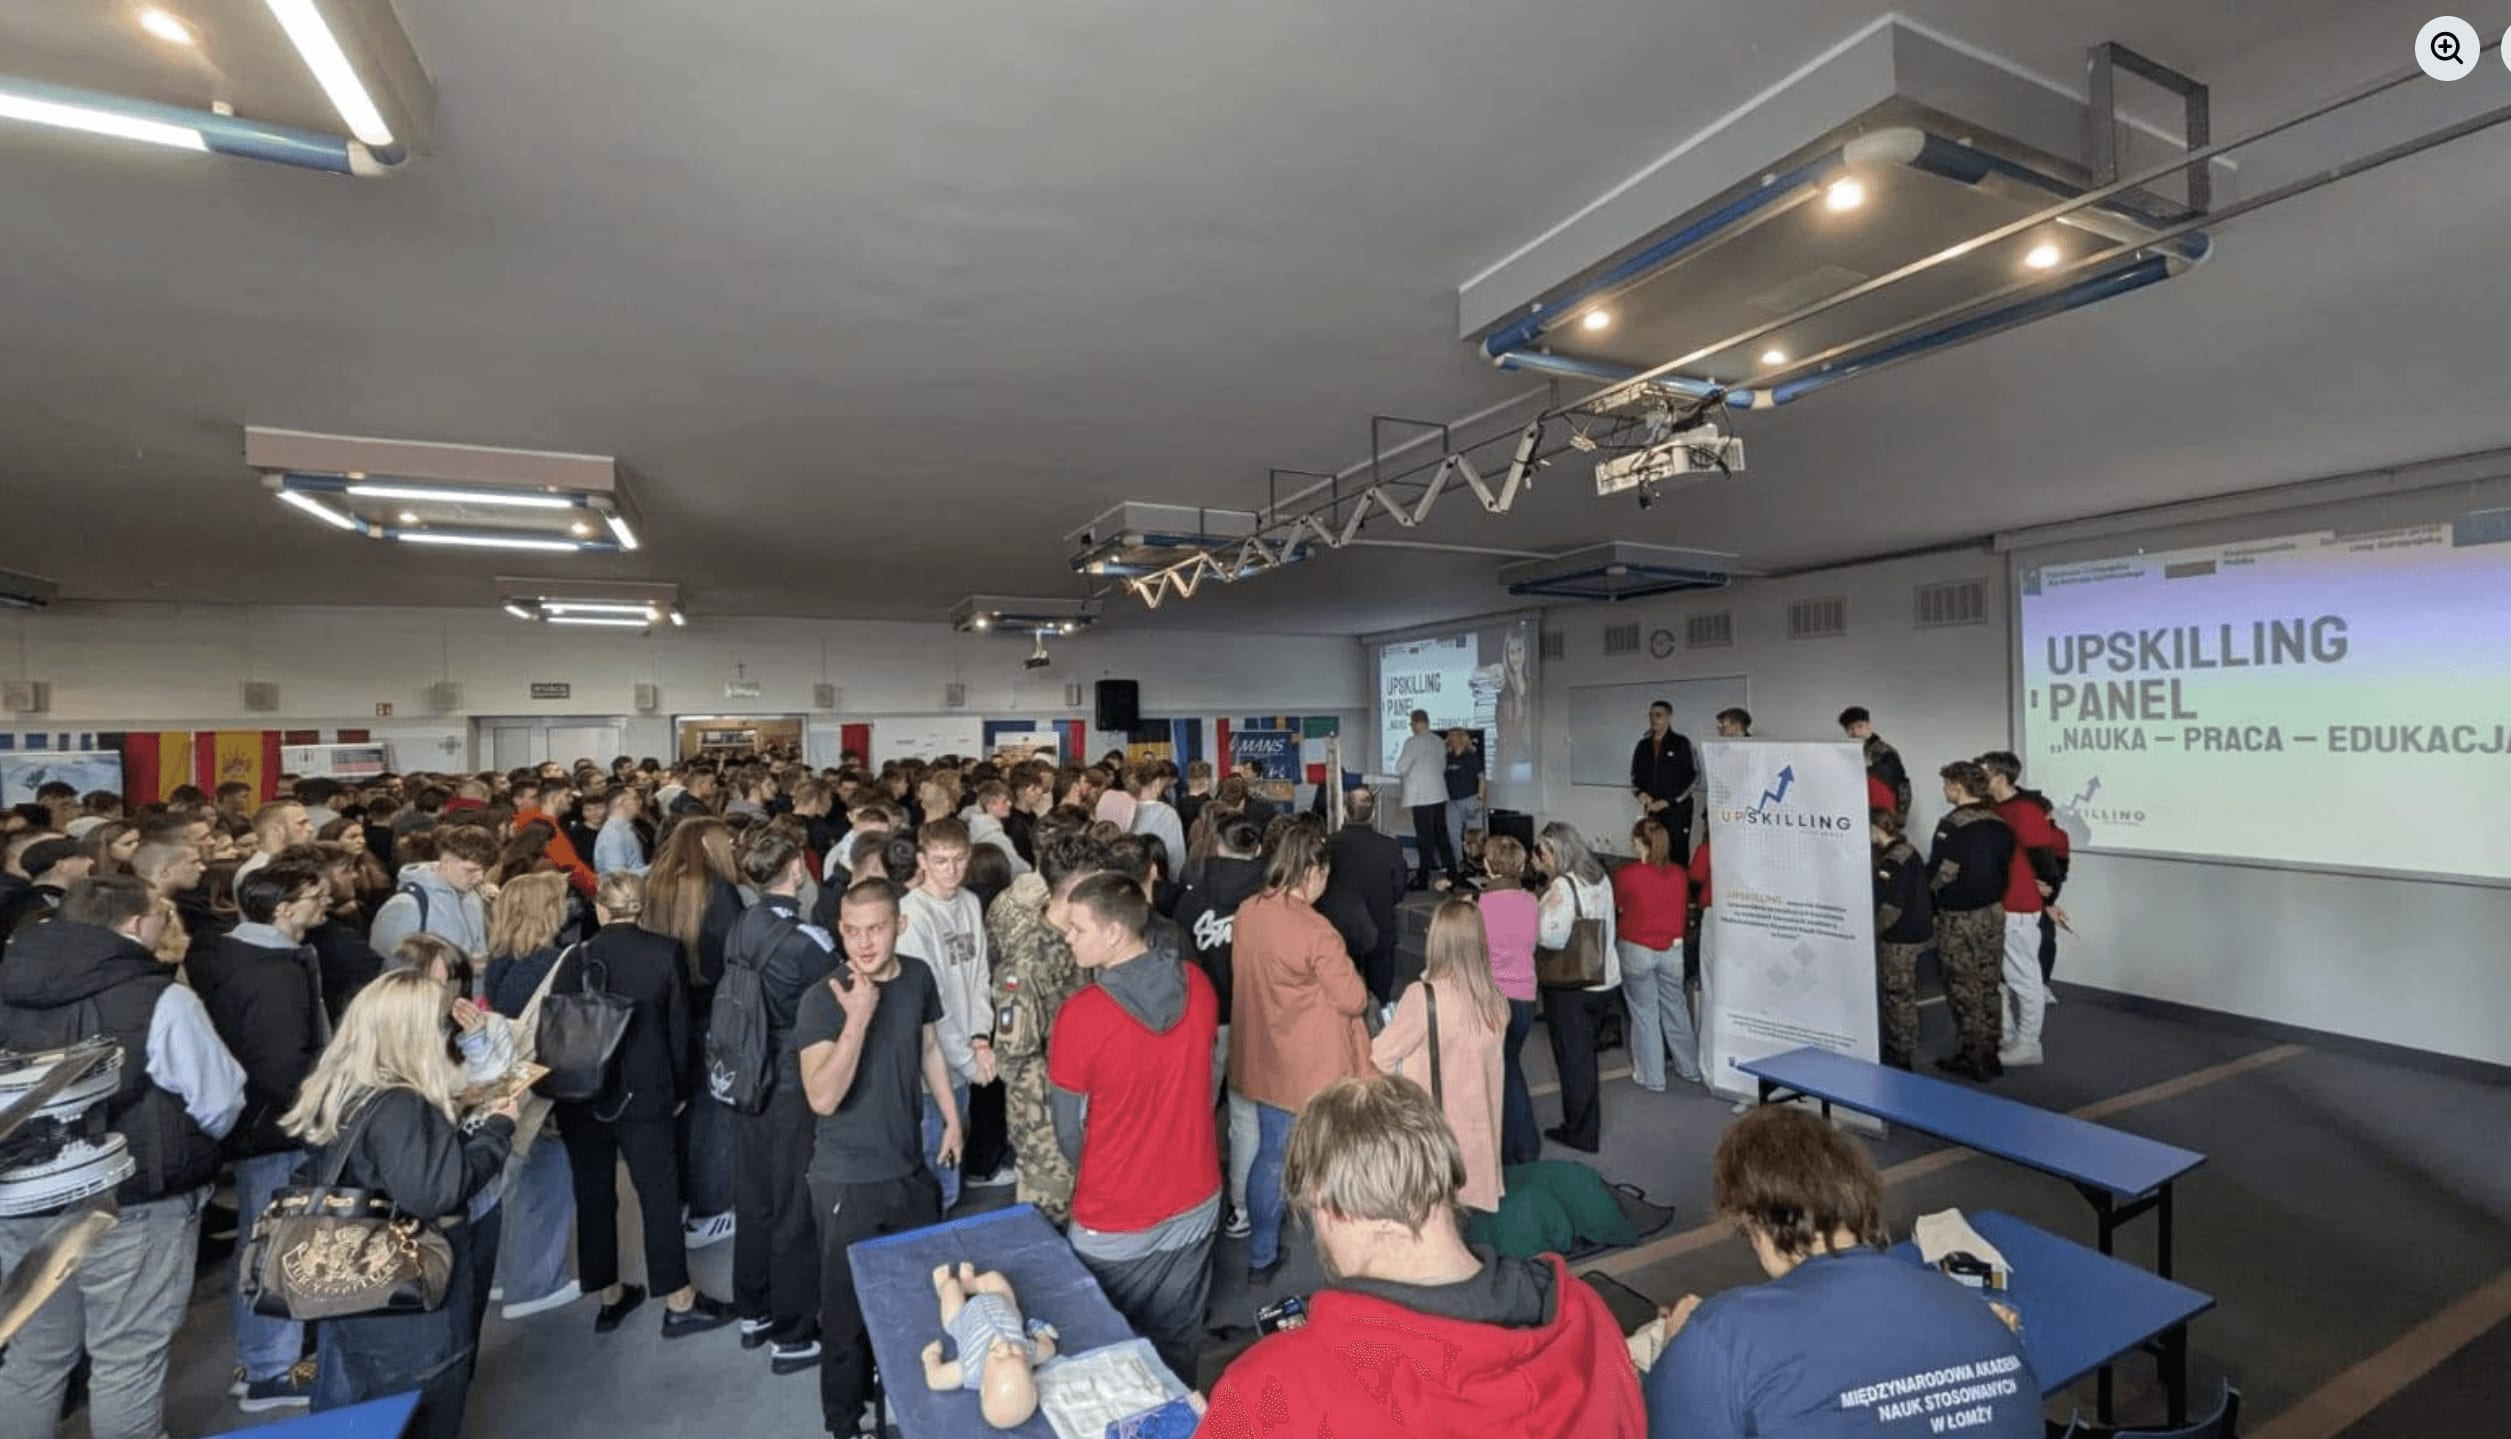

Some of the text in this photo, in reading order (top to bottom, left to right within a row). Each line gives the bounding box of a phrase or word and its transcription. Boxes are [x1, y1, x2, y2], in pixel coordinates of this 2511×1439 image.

[2046, 614, 2349, 676] UPSKILLING
[1387, 671, 1441, 696] UPSKILLING
[2049, 677, 2198, 722] PANEL
[2183, 726, 2284, 753] PRACA
[2328, 724, 2511, 754] EDUKACJ
[1721, 810, 1852, 831] UPSKILLING
[1840, 1364, 1974, 1407] MIĘDZYNARODOWA
[1878, 1379, 2018, 1423] NAUK STOSOWANYCH
[1930, 1404, 1993, 1434] W ŁOMŻY
